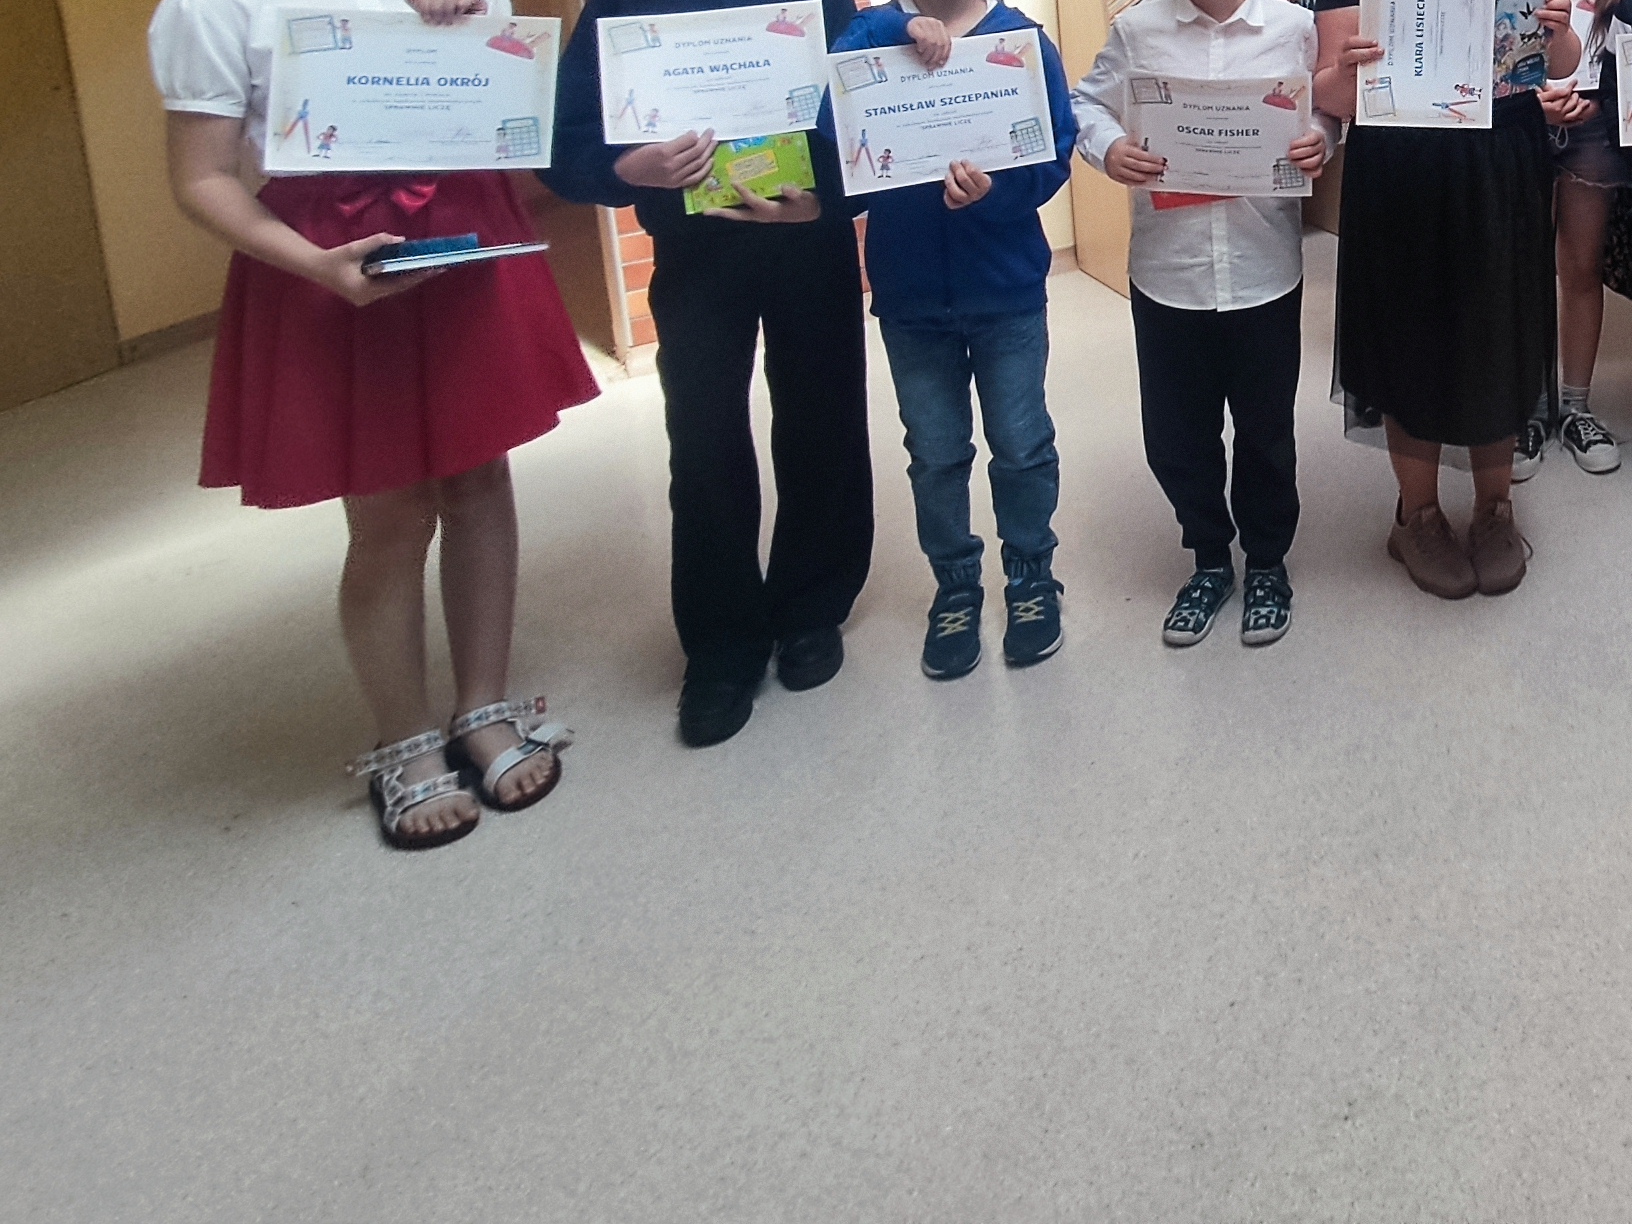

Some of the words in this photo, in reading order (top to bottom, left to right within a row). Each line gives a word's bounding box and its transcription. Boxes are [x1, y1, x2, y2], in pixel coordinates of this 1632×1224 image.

[663, 66, 705, 77] AGATA
[709, 59, 771, 74] WĄCHAŁA
[1414, 42, 1424, 77] KLARA
[346, 75, 431, 87] KORNELIA
[437, 72, 491, 87] OKRÓJ
[900, 71, 935, 83] DYPLOM
[936, 67, 974, 77] UZNANIA
[864, 99, 936, 118] STANISŁAW
[940, 87, 1019, 107] SZCZEPANIAK
[1177, 125, 1215, 137] OSCAR
[1218, 128, 1260, 137] FISHER
